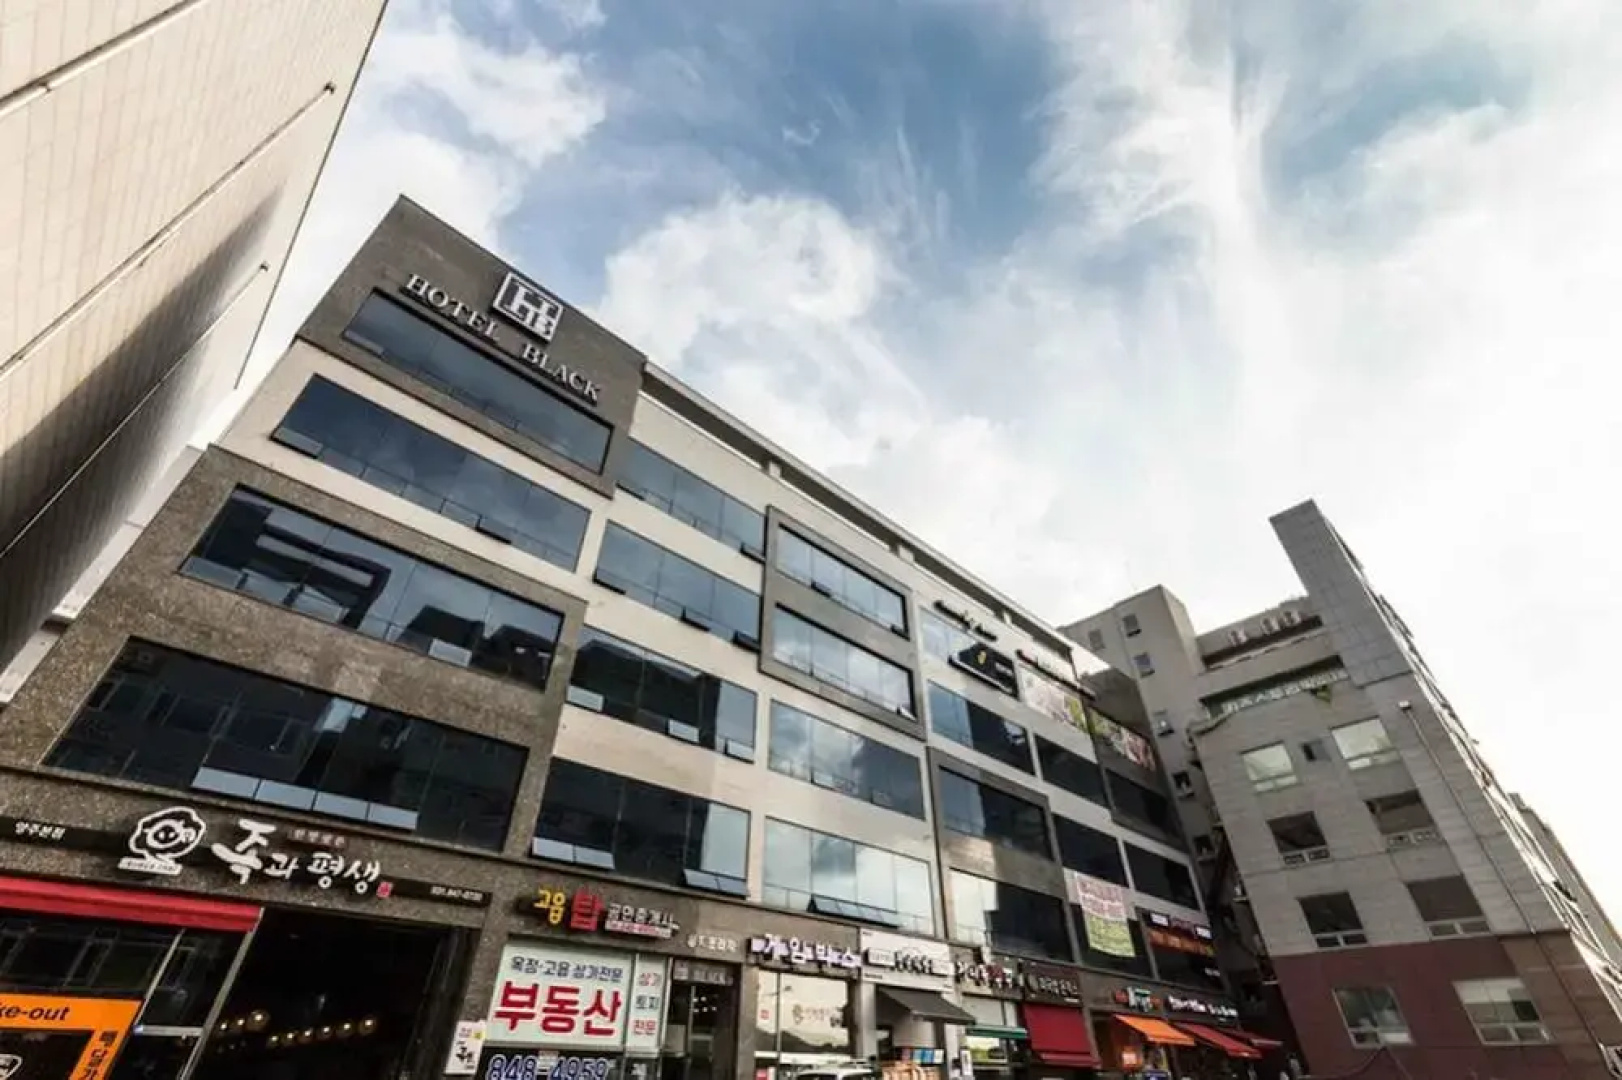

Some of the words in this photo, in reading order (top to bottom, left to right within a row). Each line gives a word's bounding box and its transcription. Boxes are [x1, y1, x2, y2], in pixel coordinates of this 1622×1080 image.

[405, 273, 500, 343] HOTEL
[522, 343, 601, 402] BLACK
[494, 980, 622, 1036] 부동산
[635, 994, 660, 1010] 토지
